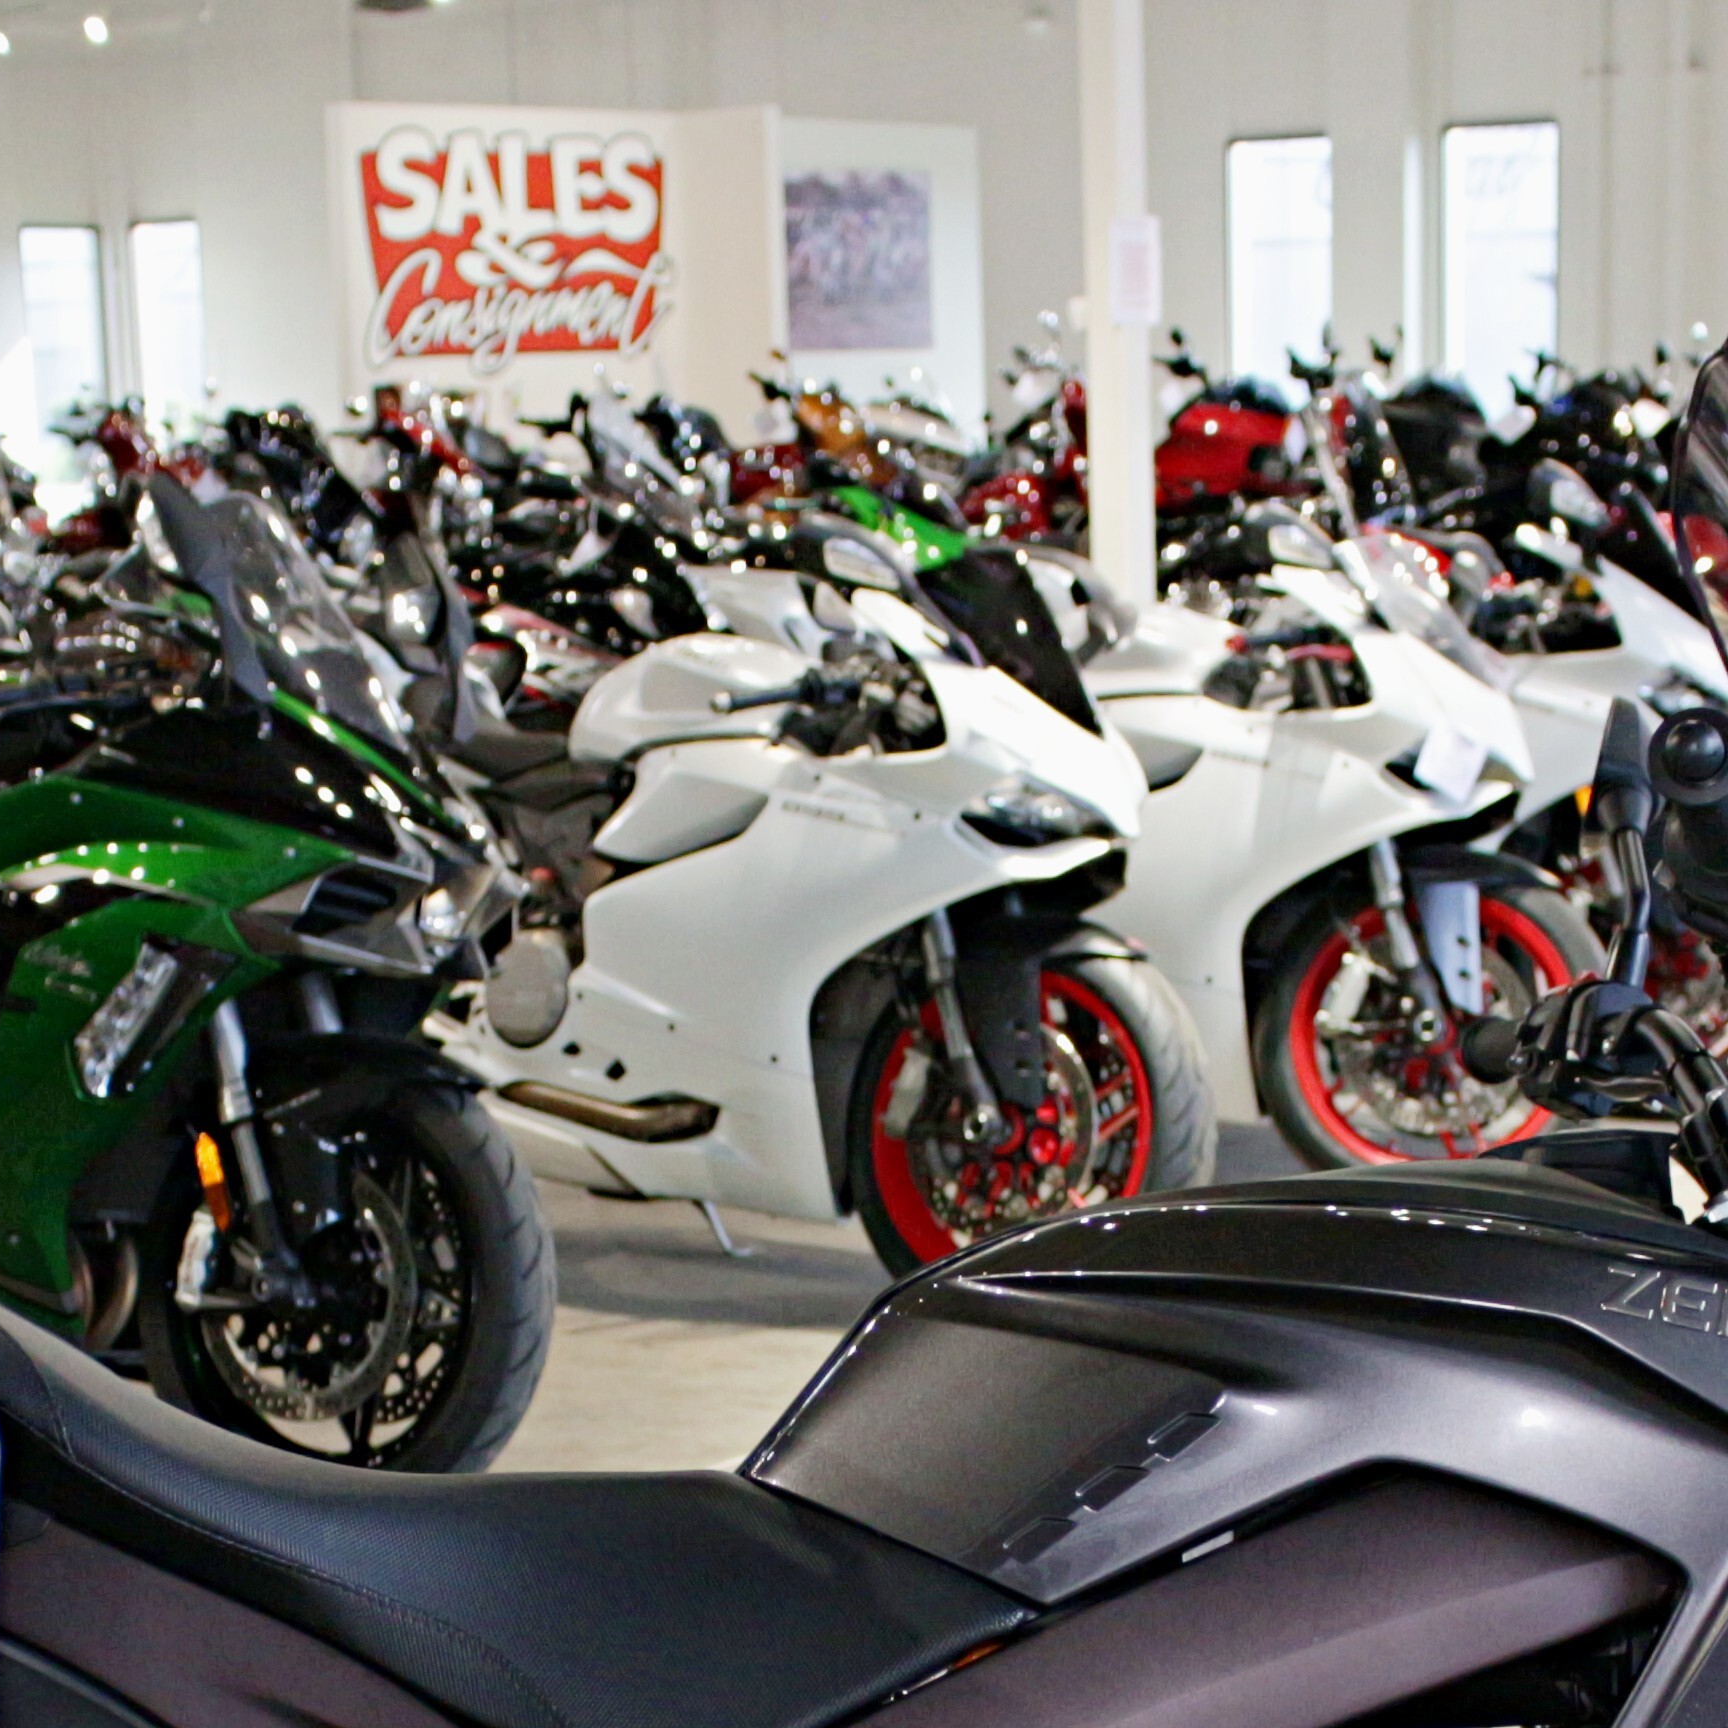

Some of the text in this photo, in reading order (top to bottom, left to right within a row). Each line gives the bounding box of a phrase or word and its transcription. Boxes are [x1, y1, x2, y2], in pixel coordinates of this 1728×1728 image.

[372, 124, 662, 244] SALES
[367, 244, 676, 375] Consignment
[456, 228, 568, 289] &
